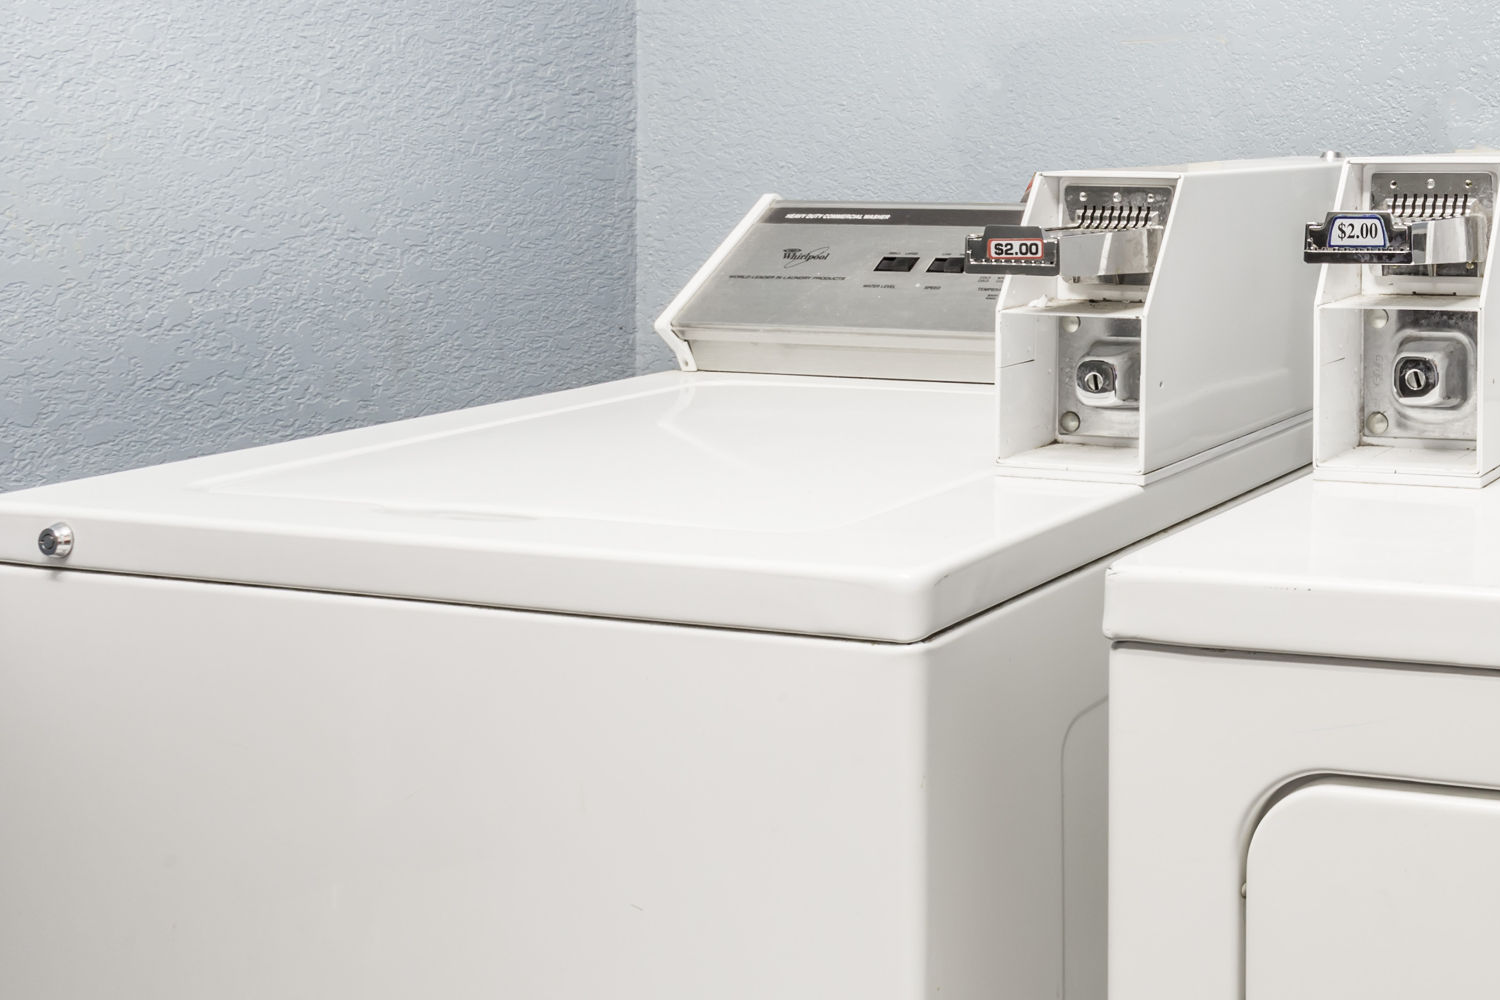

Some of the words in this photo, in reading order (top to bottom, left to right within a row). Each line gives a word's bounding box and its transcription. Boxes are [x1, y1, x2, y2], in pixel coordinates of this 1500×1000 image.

[1337, 222, 1378, 241] $2.00
[994, 243, 1039, 256] $2.00
[782, 252, 830, 262] Whirlpool
